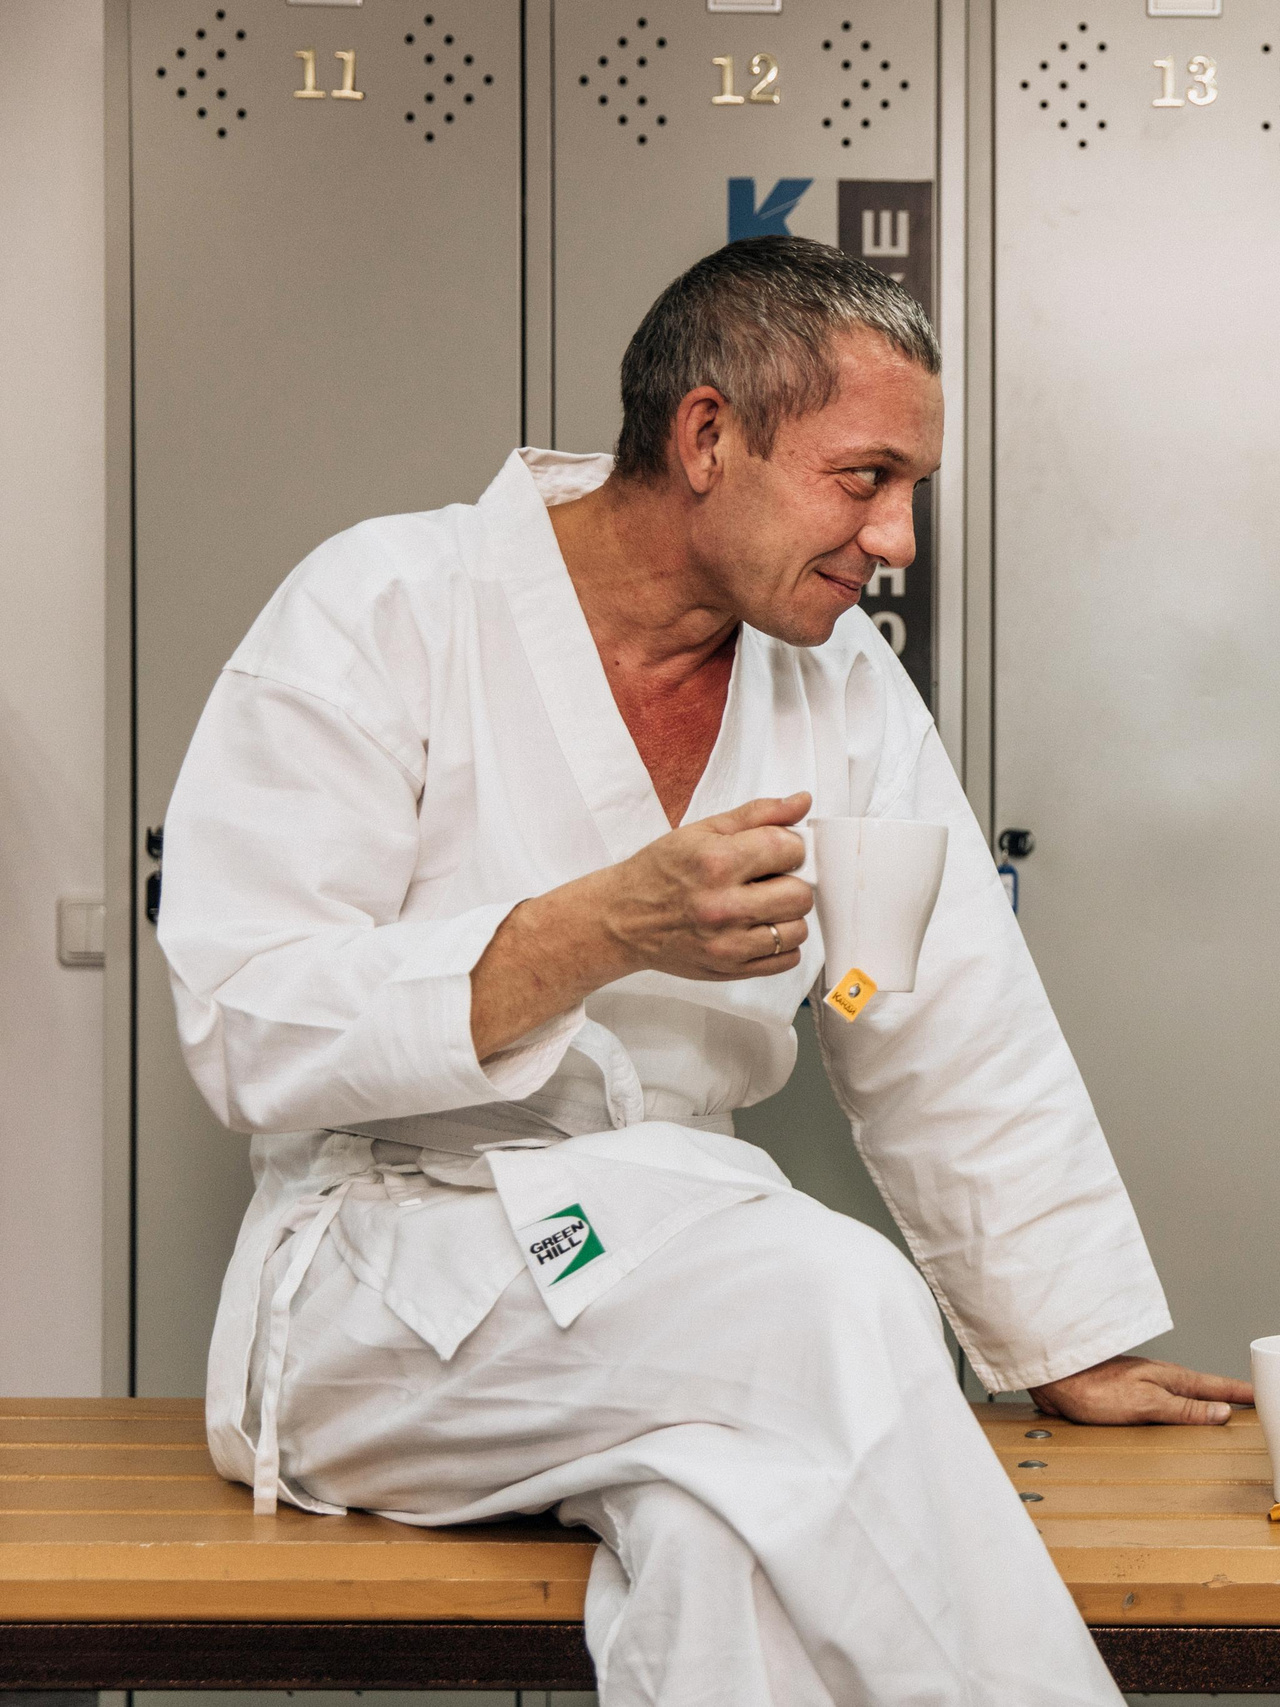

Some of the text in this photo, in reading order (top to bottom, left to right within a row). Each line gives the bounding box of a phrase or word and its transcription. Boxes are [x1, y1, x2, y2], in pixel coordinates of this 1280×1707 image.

[292, 49, 367, 101] 11
[710, 54, 782, 105] 12
[1152, 56, 1219, 108] 13
[530, 1220, 584, 1254] GREEN
[536, 1237, 582, 1265] HILL
